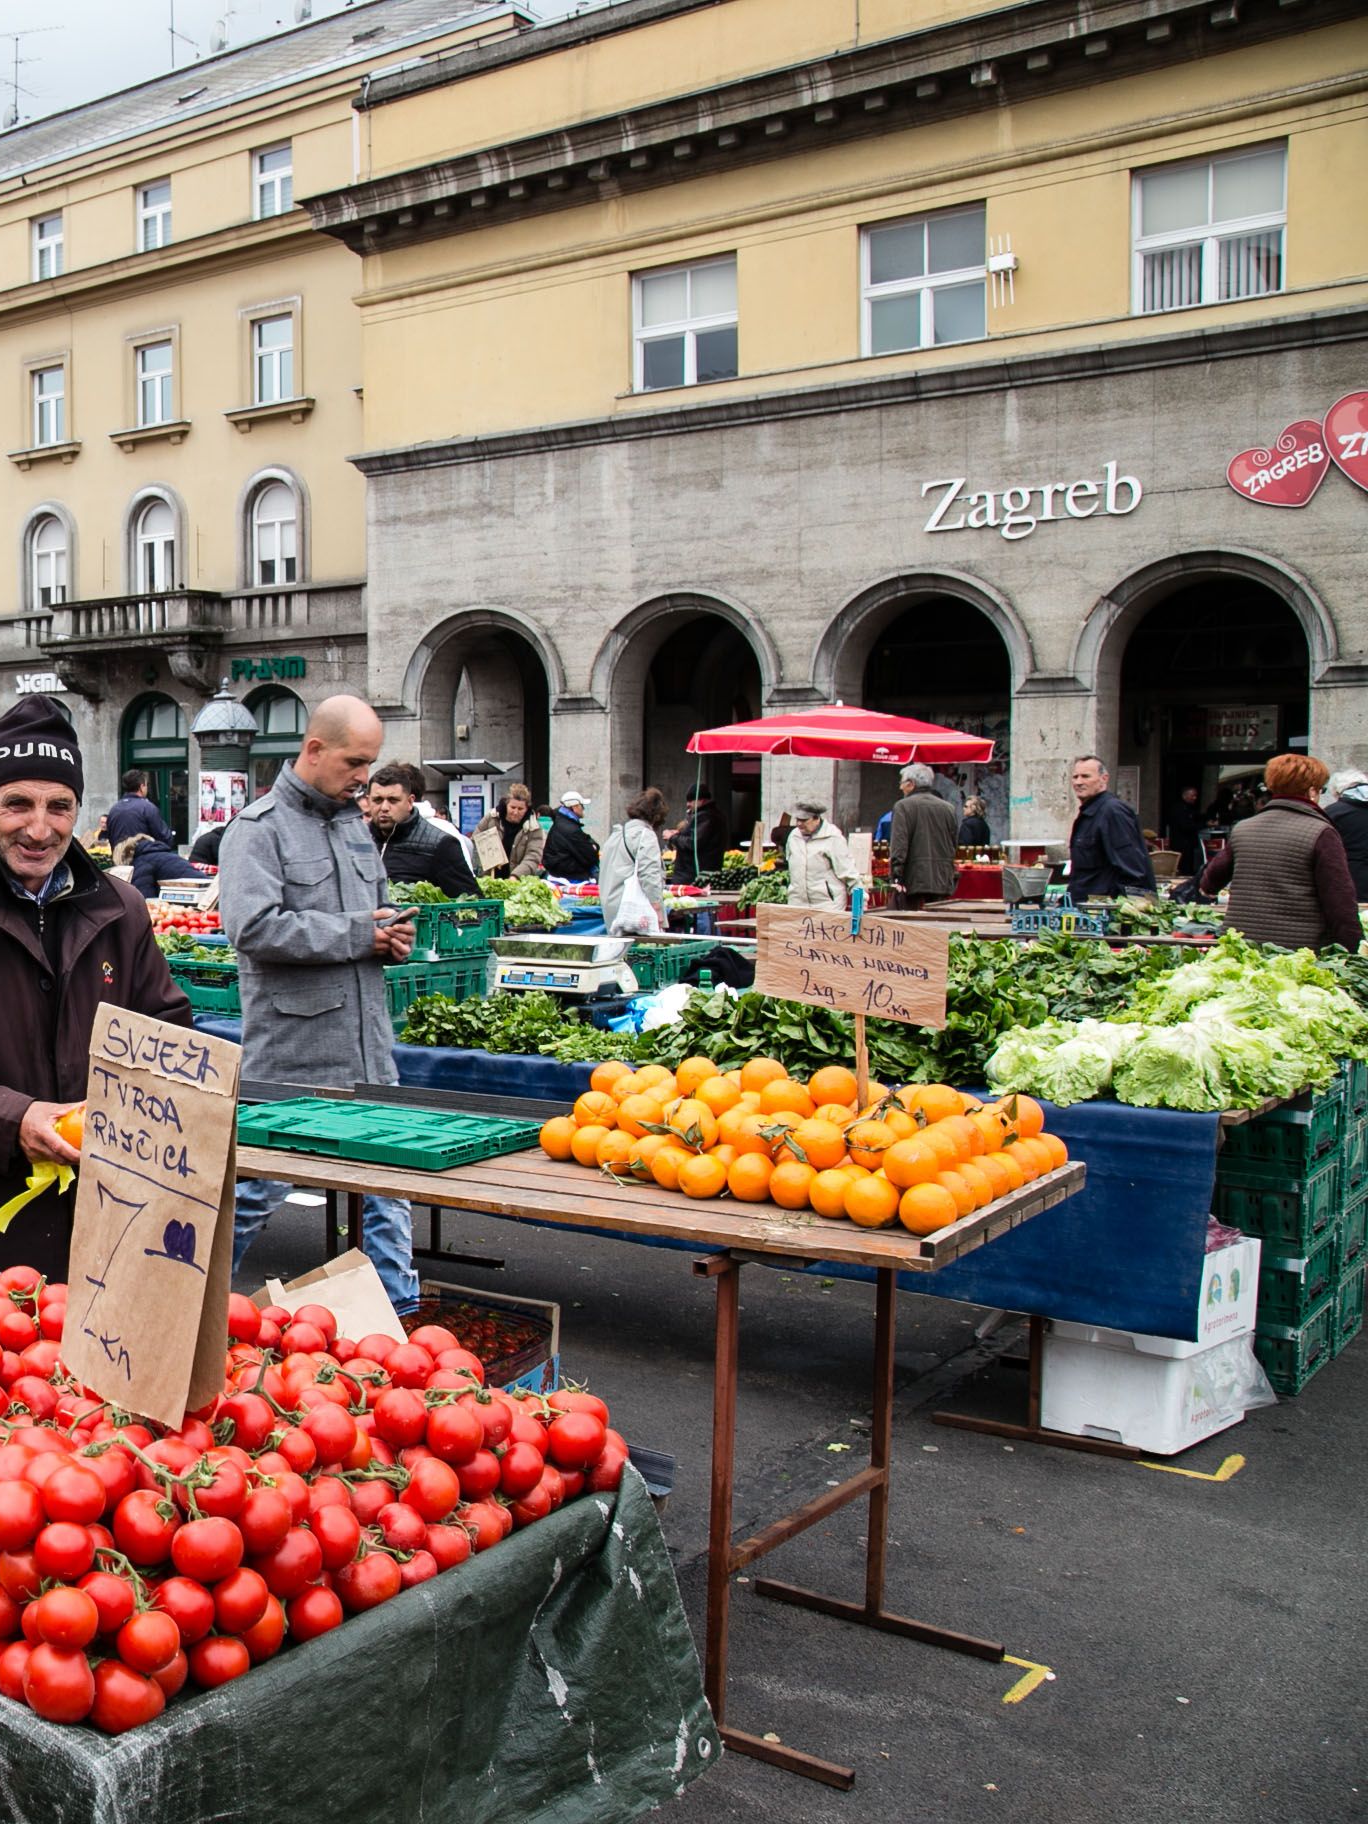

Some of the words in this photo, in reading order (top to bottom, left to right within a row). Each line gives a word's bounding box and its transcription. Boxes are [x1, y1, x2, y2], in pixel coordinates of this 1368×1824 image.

[921, 460, 1143, 540] Zagreb
[1243, 442, 1325, 496] ZAGREB
[784, 941, 855, 969] SLATKA
[103, 1018, 220, 1084] SVJEŽA
[93, 1066, 184, 1134] TVRDA
[90, 1110, 197, 1178] RAJČICA
